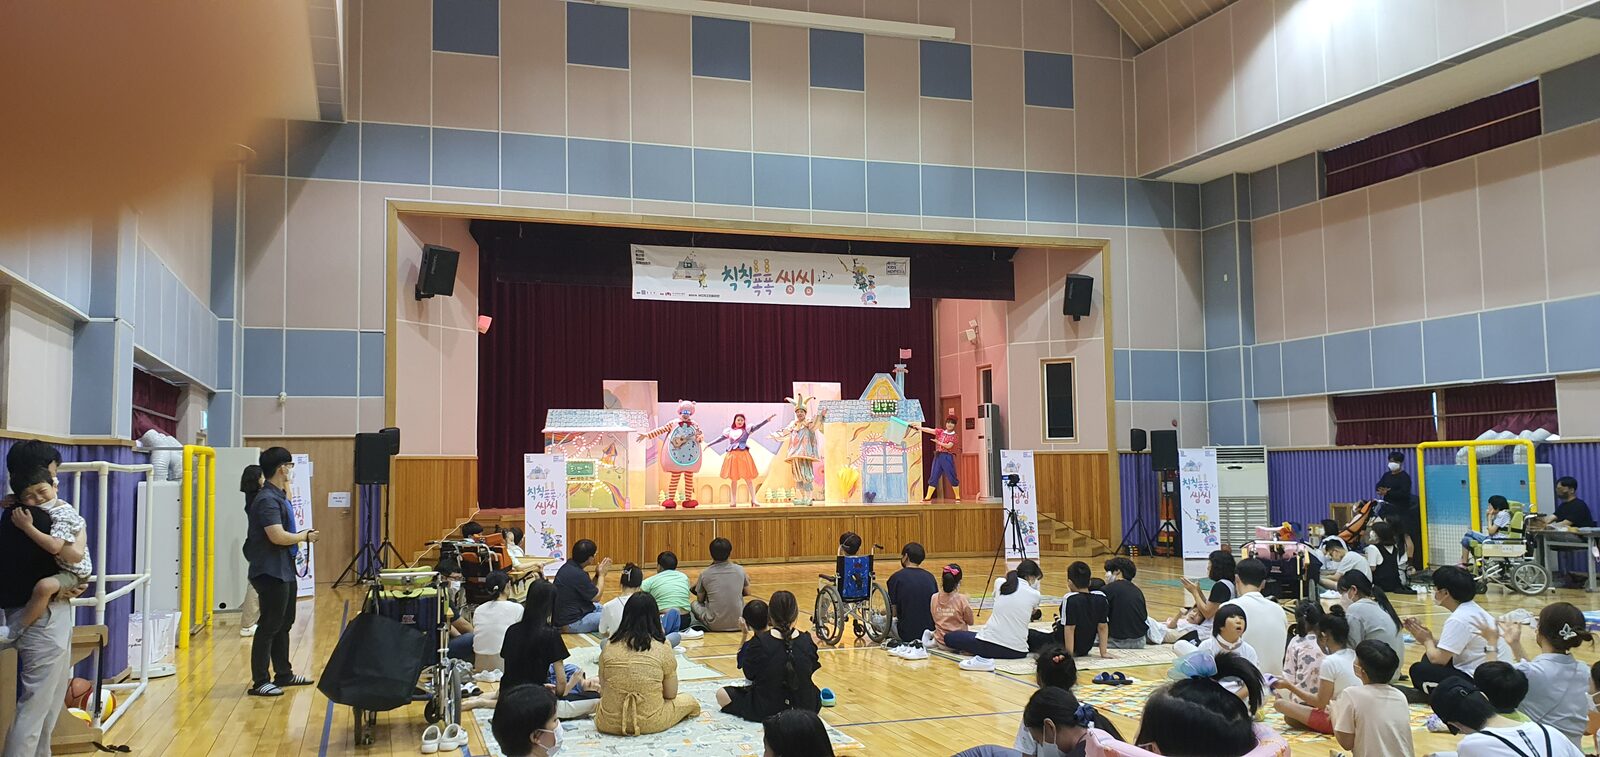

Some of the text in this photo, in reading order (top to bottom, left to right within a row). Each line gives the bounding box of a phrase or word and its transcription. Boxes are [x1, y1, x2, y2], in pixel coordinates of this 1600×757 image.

[722, 263, 815, 296] 칙칙폭폭 씽씽
[1190, 490, 1211, 504] 씽씽
[535, 499, 558, 515] 씽씽
